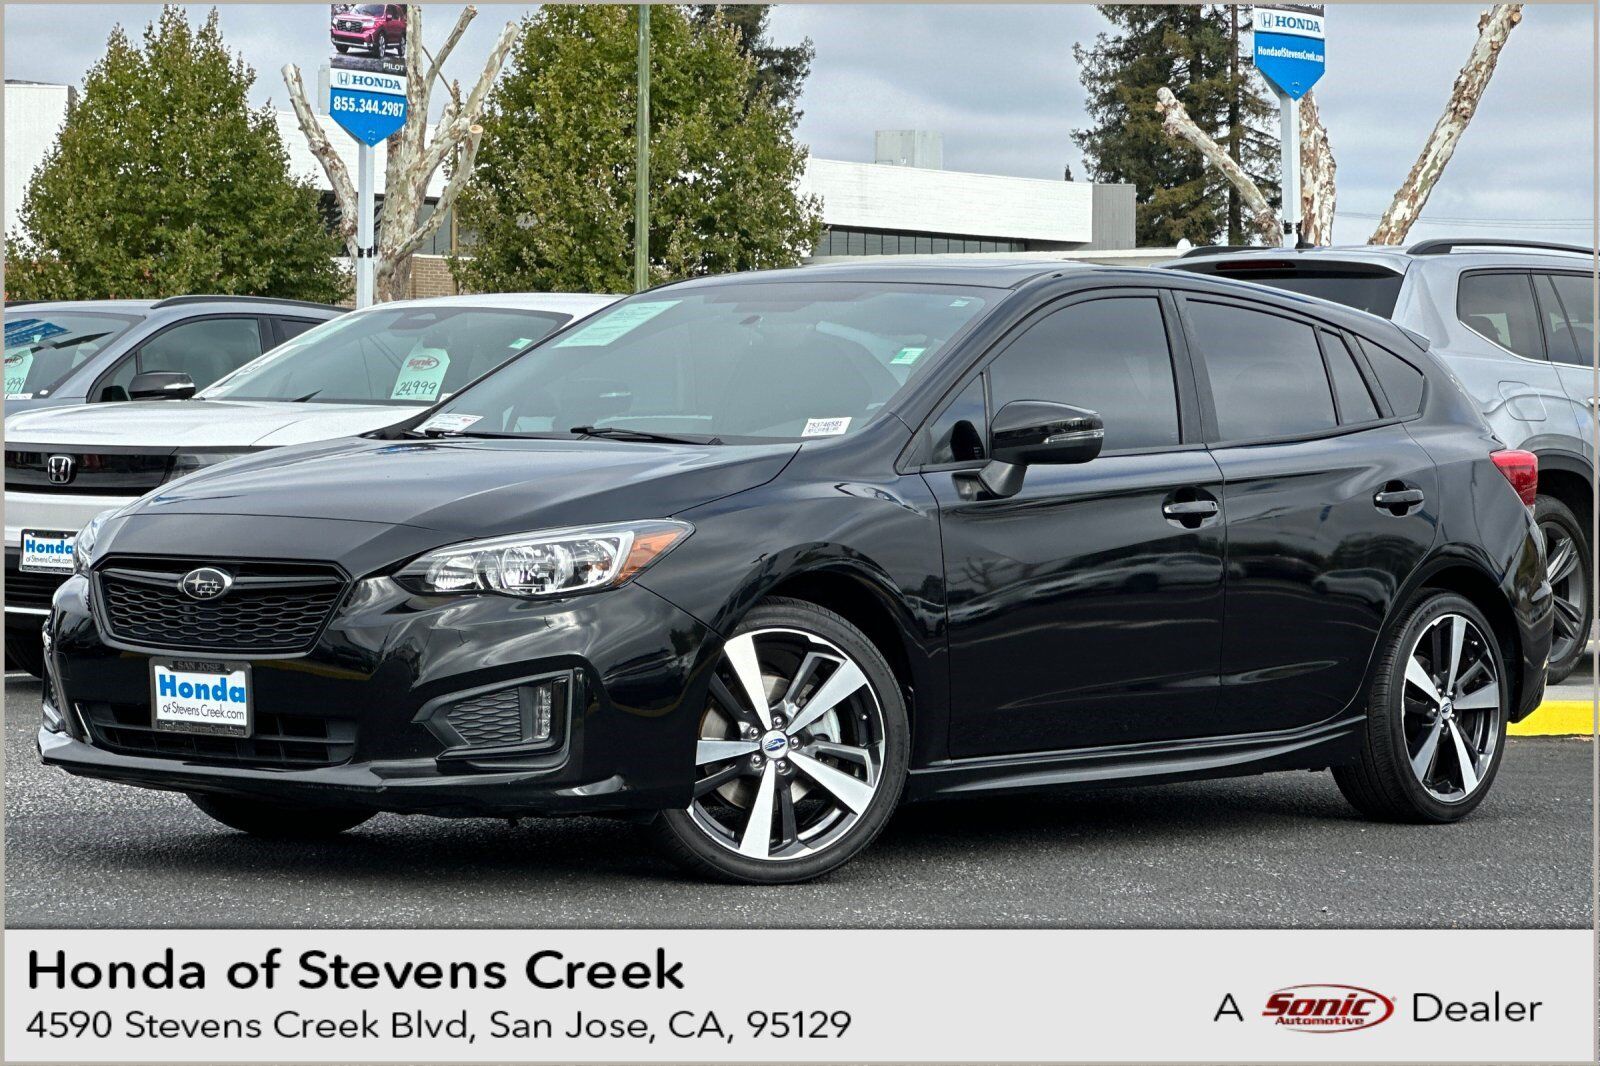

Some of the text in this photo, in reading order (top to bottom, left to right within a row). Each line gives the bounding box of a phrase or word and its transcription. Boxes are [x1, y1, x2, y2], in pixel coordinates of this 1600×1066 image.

[1275, 15, 1321, 32] HONDA
[383, 62, 404, 71] PILOT
[351, 74, 401, 90] HONDA
[333, 95, 405, 117] 855.344.2987
[25, 539, 73, 555] Honda
[177, 661, 221, 672] SAN JOSE
[158, 673, 246, 704] Honda
[162, 703, 171, 714] of
[171, 701, 200, 717] Stevens
